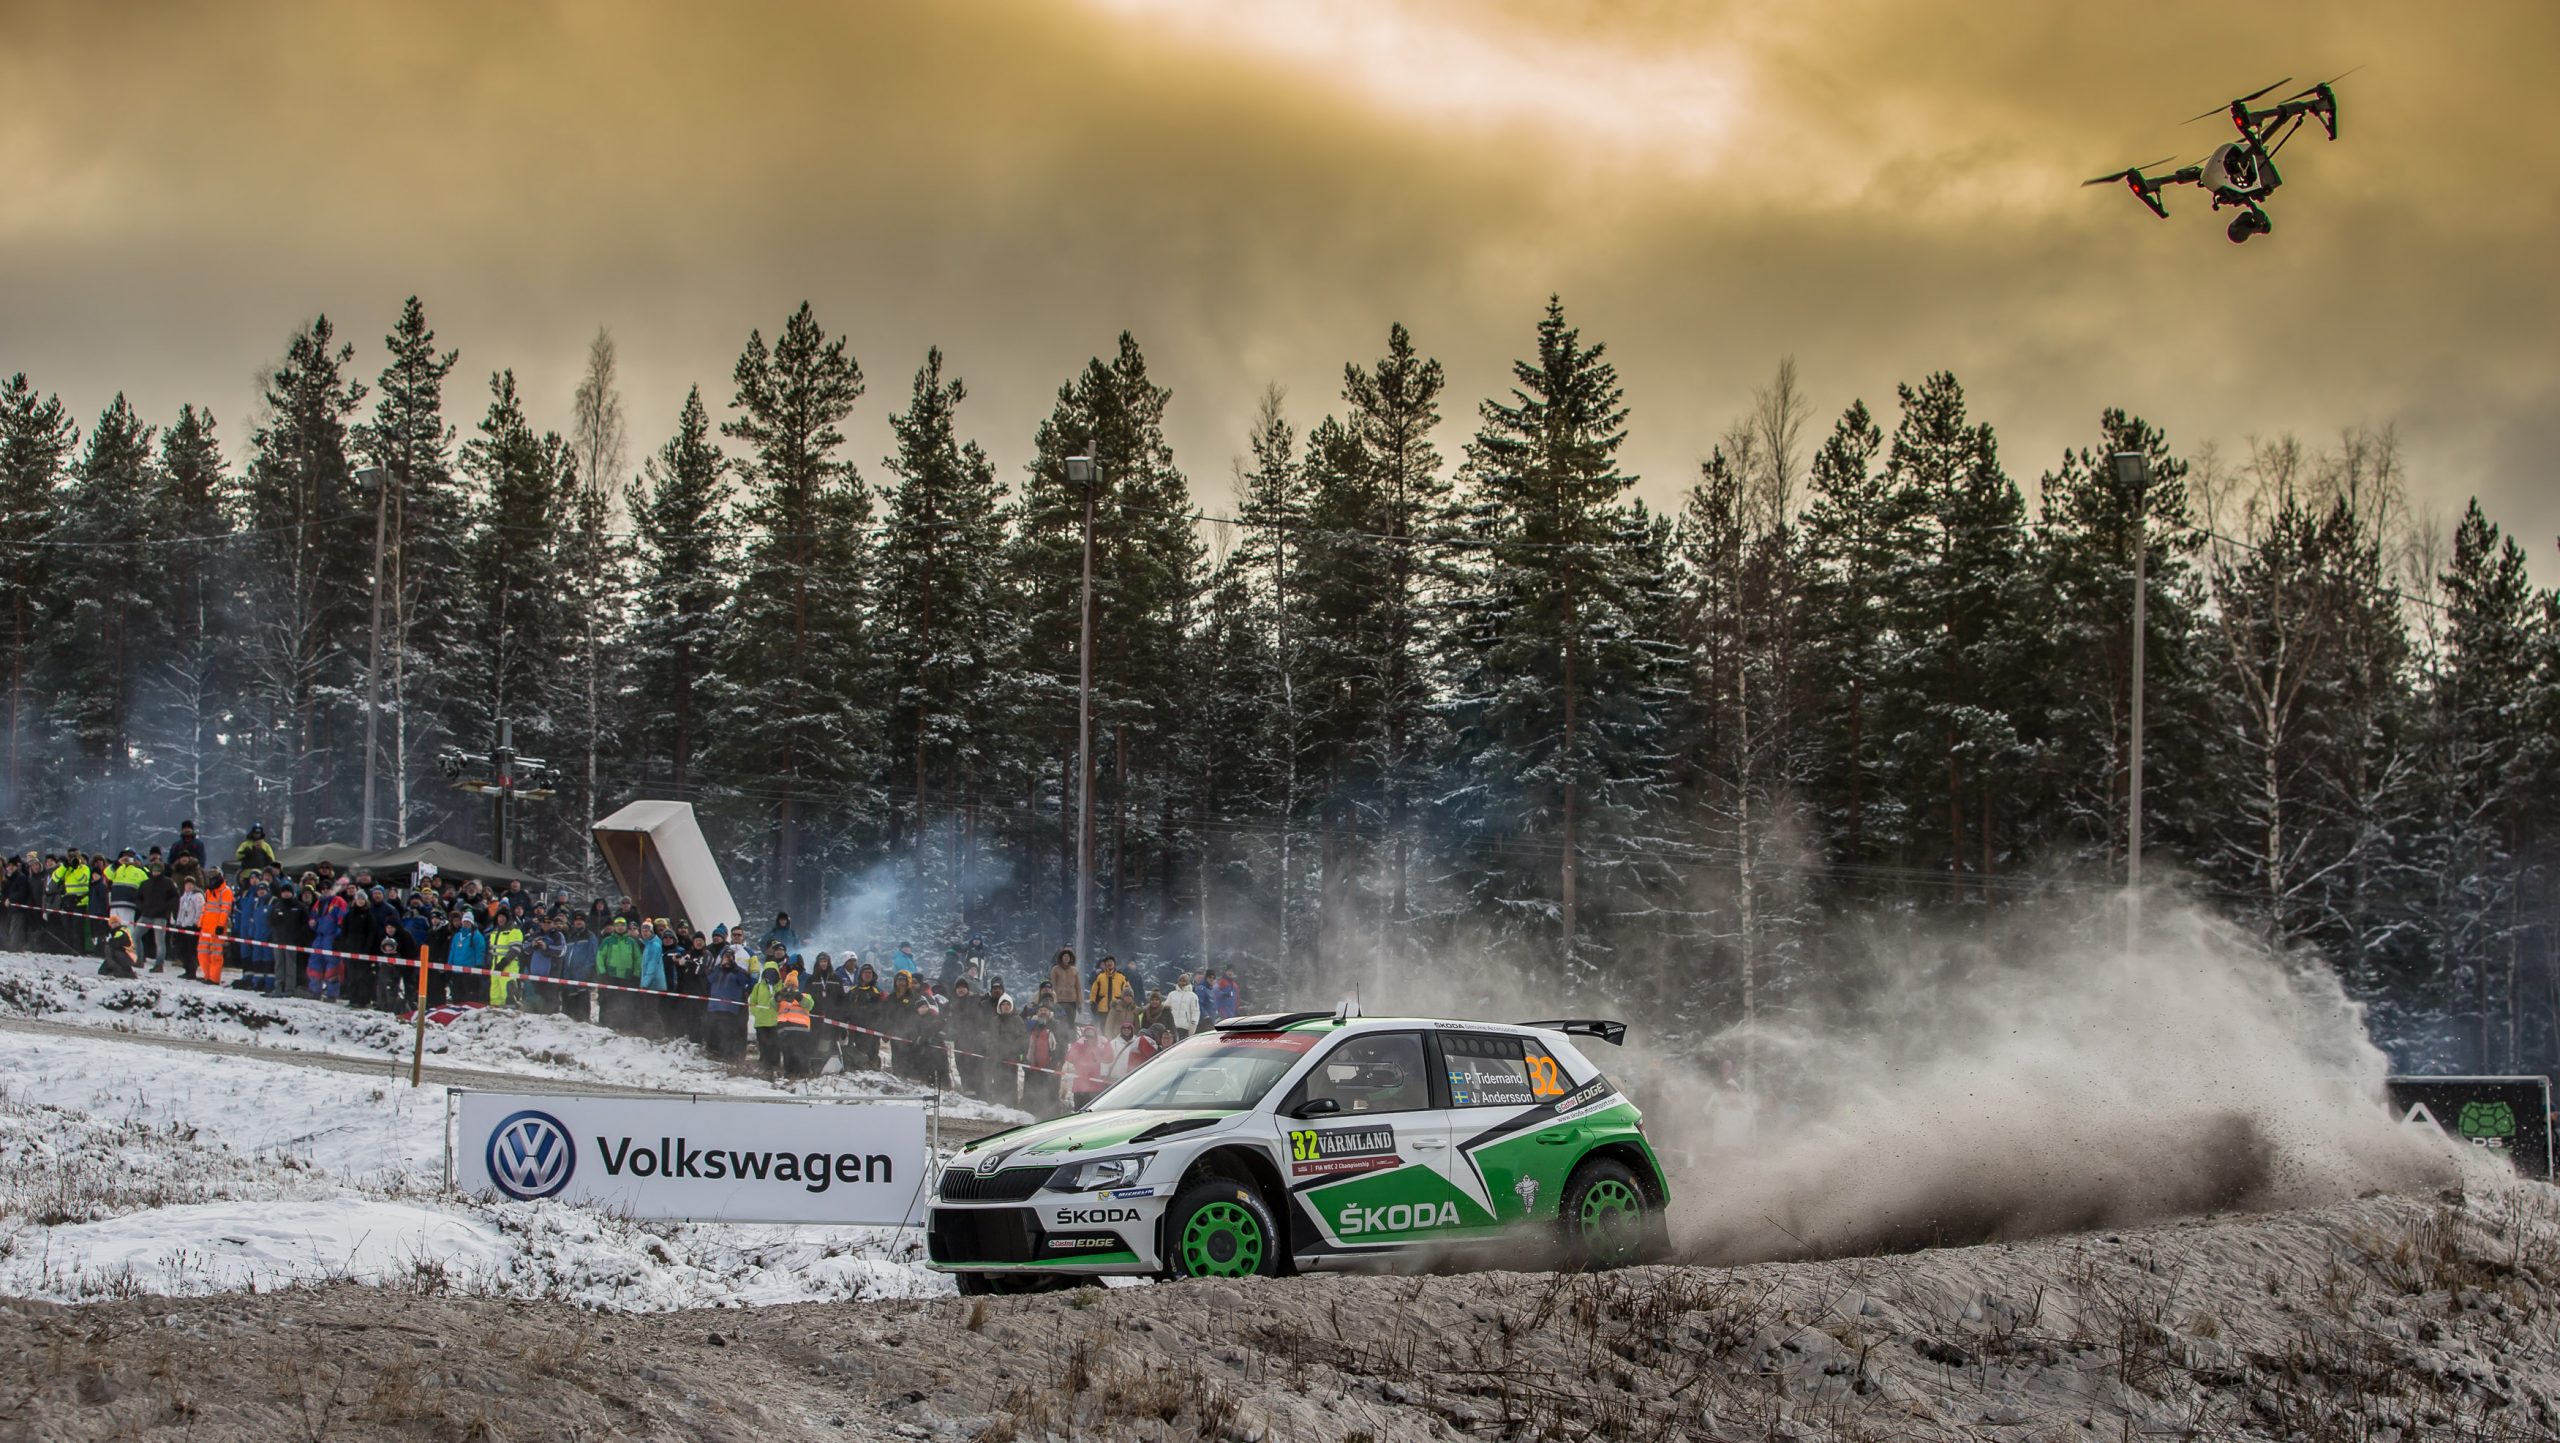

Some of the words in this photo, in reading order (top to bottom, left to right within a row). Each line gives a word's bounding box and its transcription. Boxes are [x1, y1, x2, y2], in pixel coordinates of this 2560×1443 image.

[1434, 1021, 1465, 1030] ŠKODA
[1464, 1073, 1474, 1084] P.
[1477, 1072, 1523, 1085] Tidemand
[1525, 1056, 1564, 1096] 32
[1471, 1092, 1480, 1104] J.
[1482, 1091, 1533, 1103] Andersson
[1576, 1082, 1605, 1104] EDGE
[1291, 1130, 1320, 1160] 32
[1318, 1131, 1392, 1153] VÄRMLAND
[597, 1136, 893, 1193] Volkswagen
[1315, 1164, 1323, 1172] FIA
[1323, 1163, 1334, 1171] WRC
[1338, 1160, 1370, 1170] Championship
[1118, 1189, 1154, 1197] MICHELIN
[1056, 1207, 1142, 1225] ŠKODA
[1339, 1201, 1461, 1234] ŠKODA
[1076, 1238, 1115, 1248] EDGE
